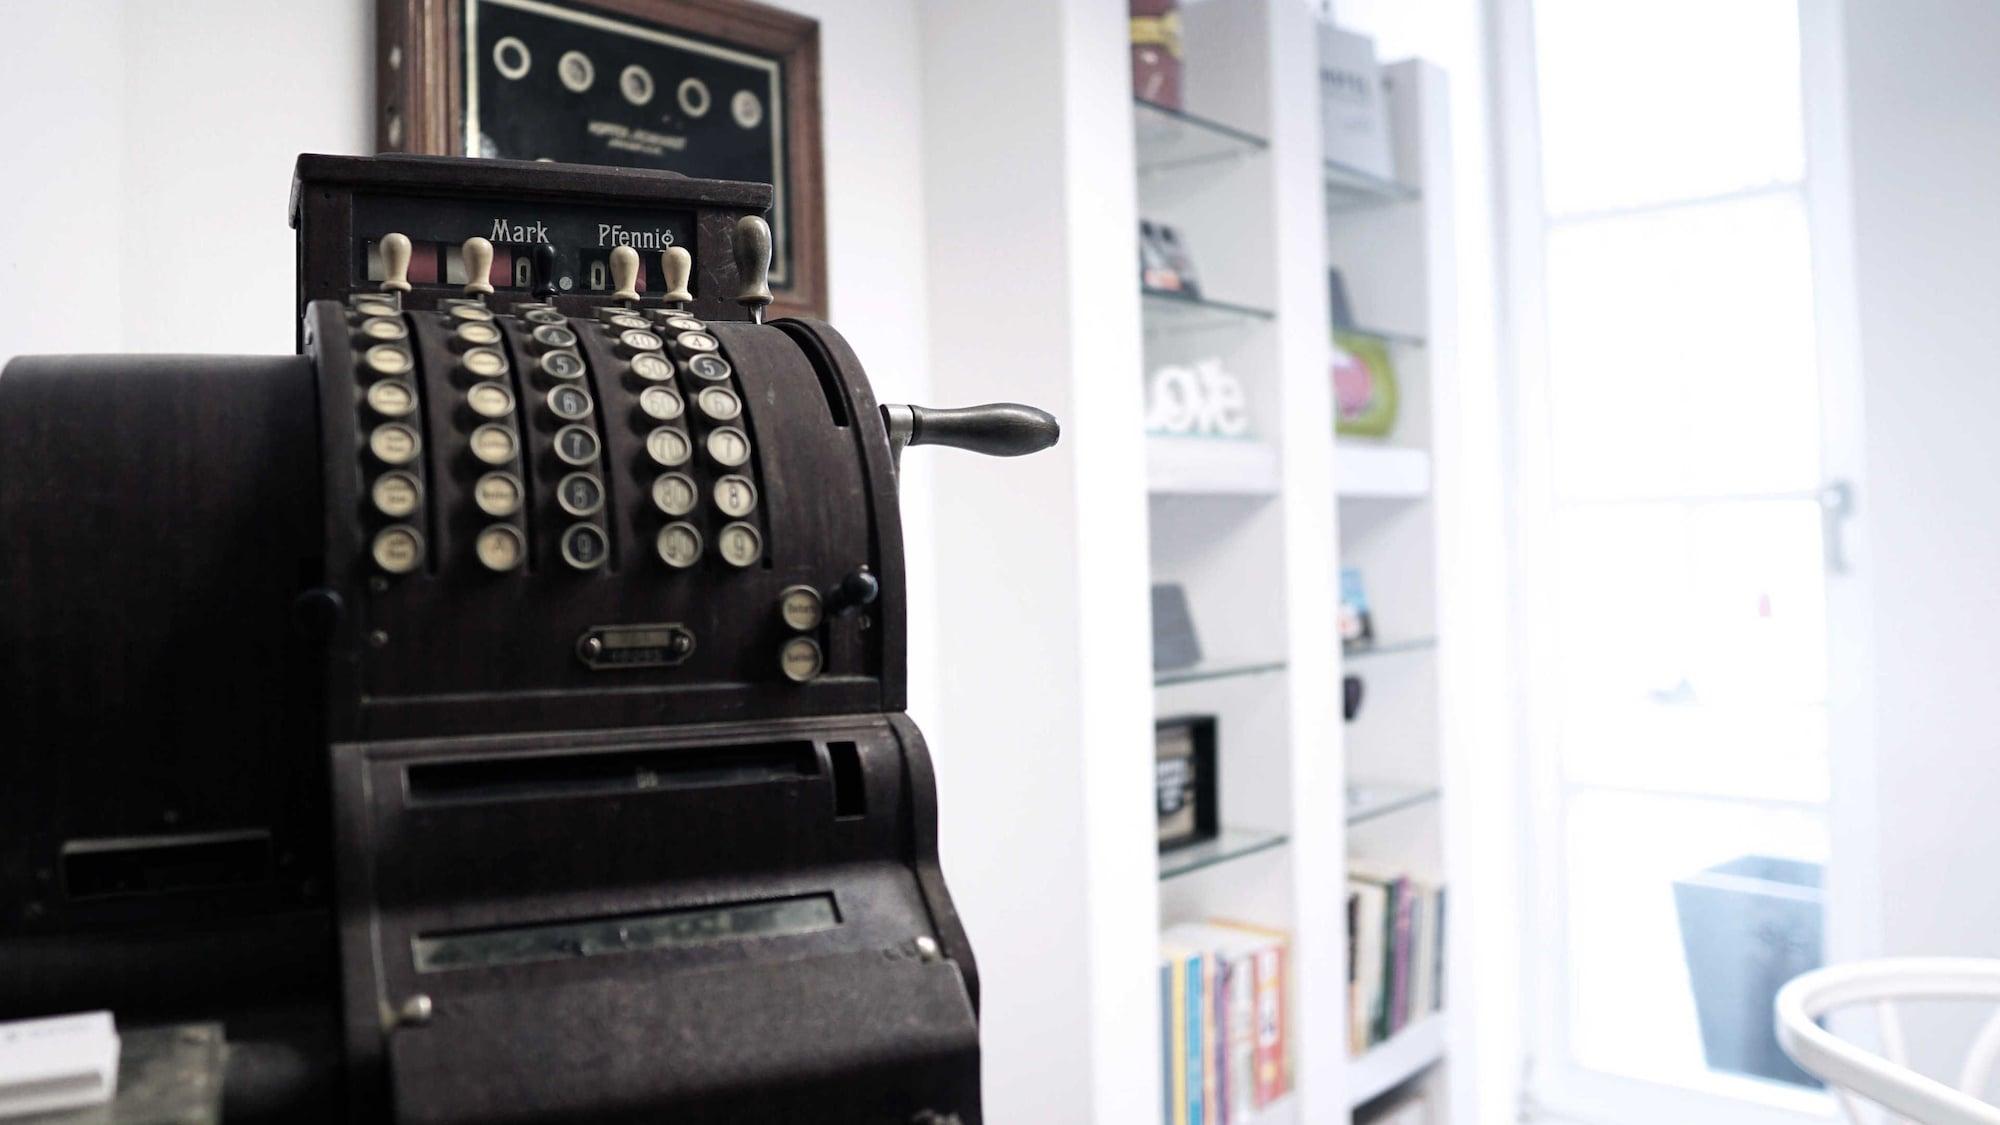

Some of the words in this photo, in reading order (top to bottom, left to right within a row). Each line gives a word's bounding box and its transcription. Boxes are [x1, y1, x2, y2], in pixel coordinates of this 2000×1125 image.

[489, 219, 549, 244] Mark
[598, 224, 674, 253] Pfennig
[630, 333, 653, 347] 40
[556, 358, 569, 375] 5
[643, 359, 664, 378] 50
[702, 359, 716, 376] 5
[563, 392, 577, 414] 6
[722, 436, 733, 459] 7
[729, 484, 740, 509] 8
[734, 531, 745, 559] 9
